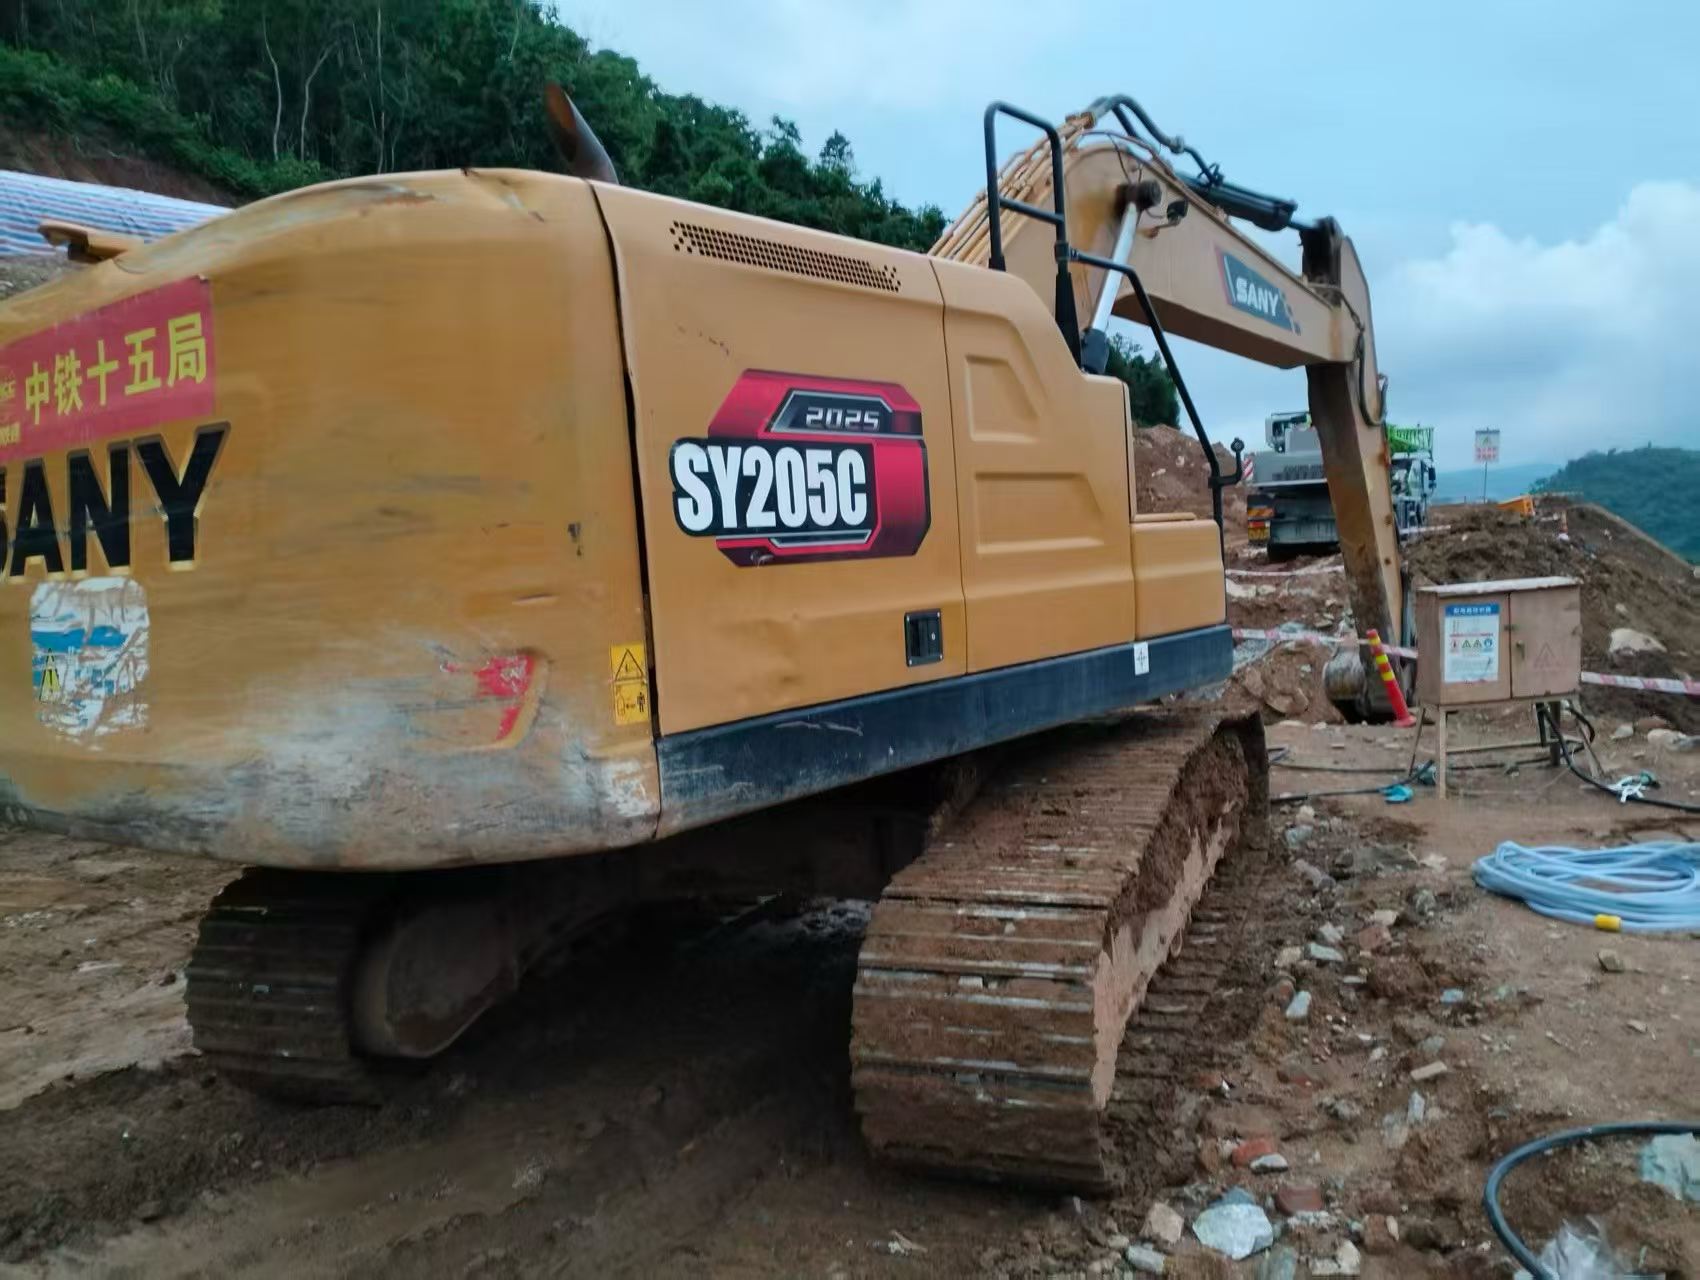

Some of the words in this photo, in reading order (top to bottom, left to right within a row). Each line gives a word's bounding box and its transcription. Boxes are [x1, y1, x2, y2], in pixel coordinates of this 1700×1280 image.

[1236, 277, 1279, 316] SANY
[25, 313, 207, 425] 中铁十五局
[806, 406, 880, 431] 2025
[0, 421, 231, 577] ANY
[673, 442, 868, 532] SY205C
